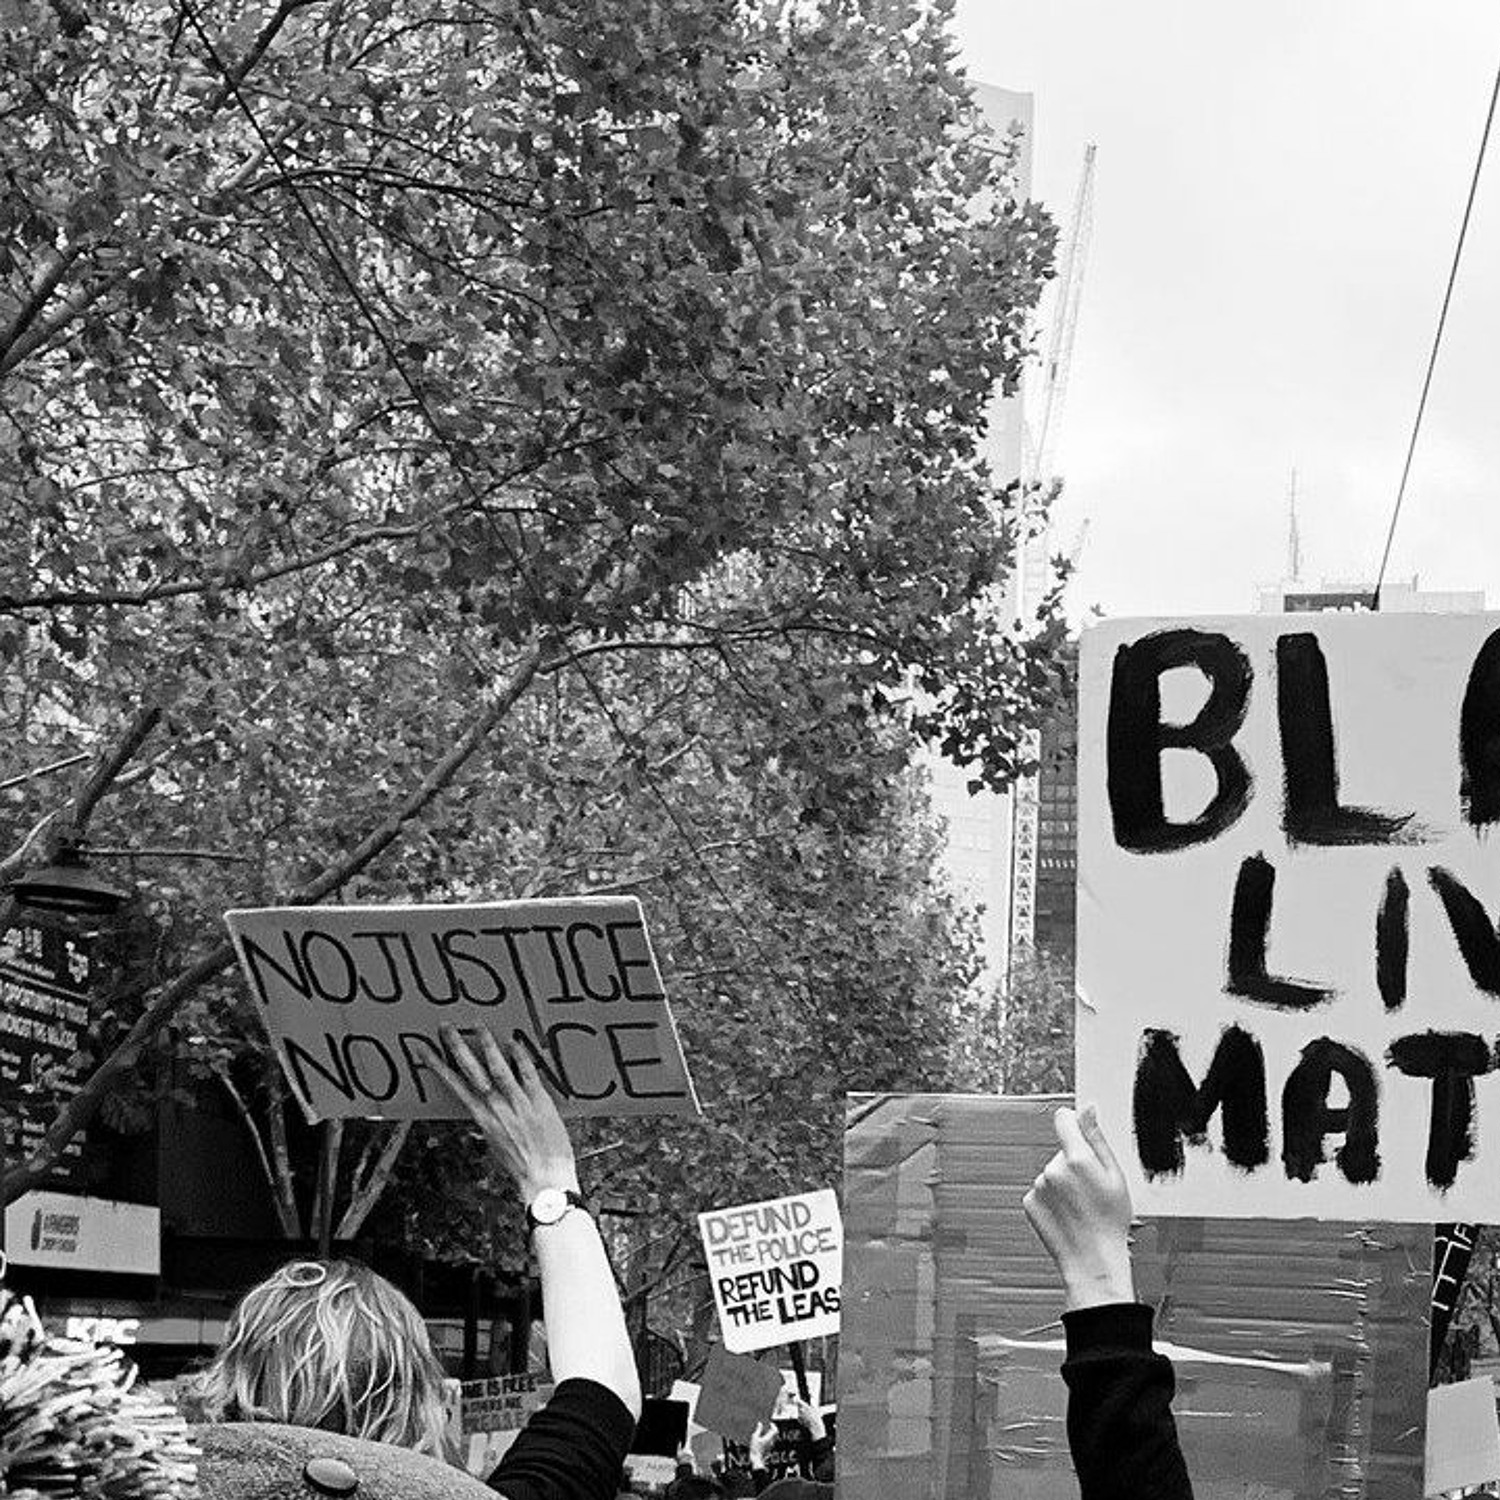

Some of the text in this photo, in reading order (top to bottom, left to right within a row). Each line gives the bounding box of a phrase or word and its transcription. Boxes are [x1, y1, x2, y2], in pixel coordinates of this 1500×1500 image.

[240, 920, 666, 1040] NO JUSTICE
[283, 1033, 399, 1102] NO
[705, 1201, 811, 1245] DEFUND
[712, 1226, 838, 1267] THE POLICE
[718, 1259, 820, 1306] REFUND
[726, 1299, 774, 1327] THE
